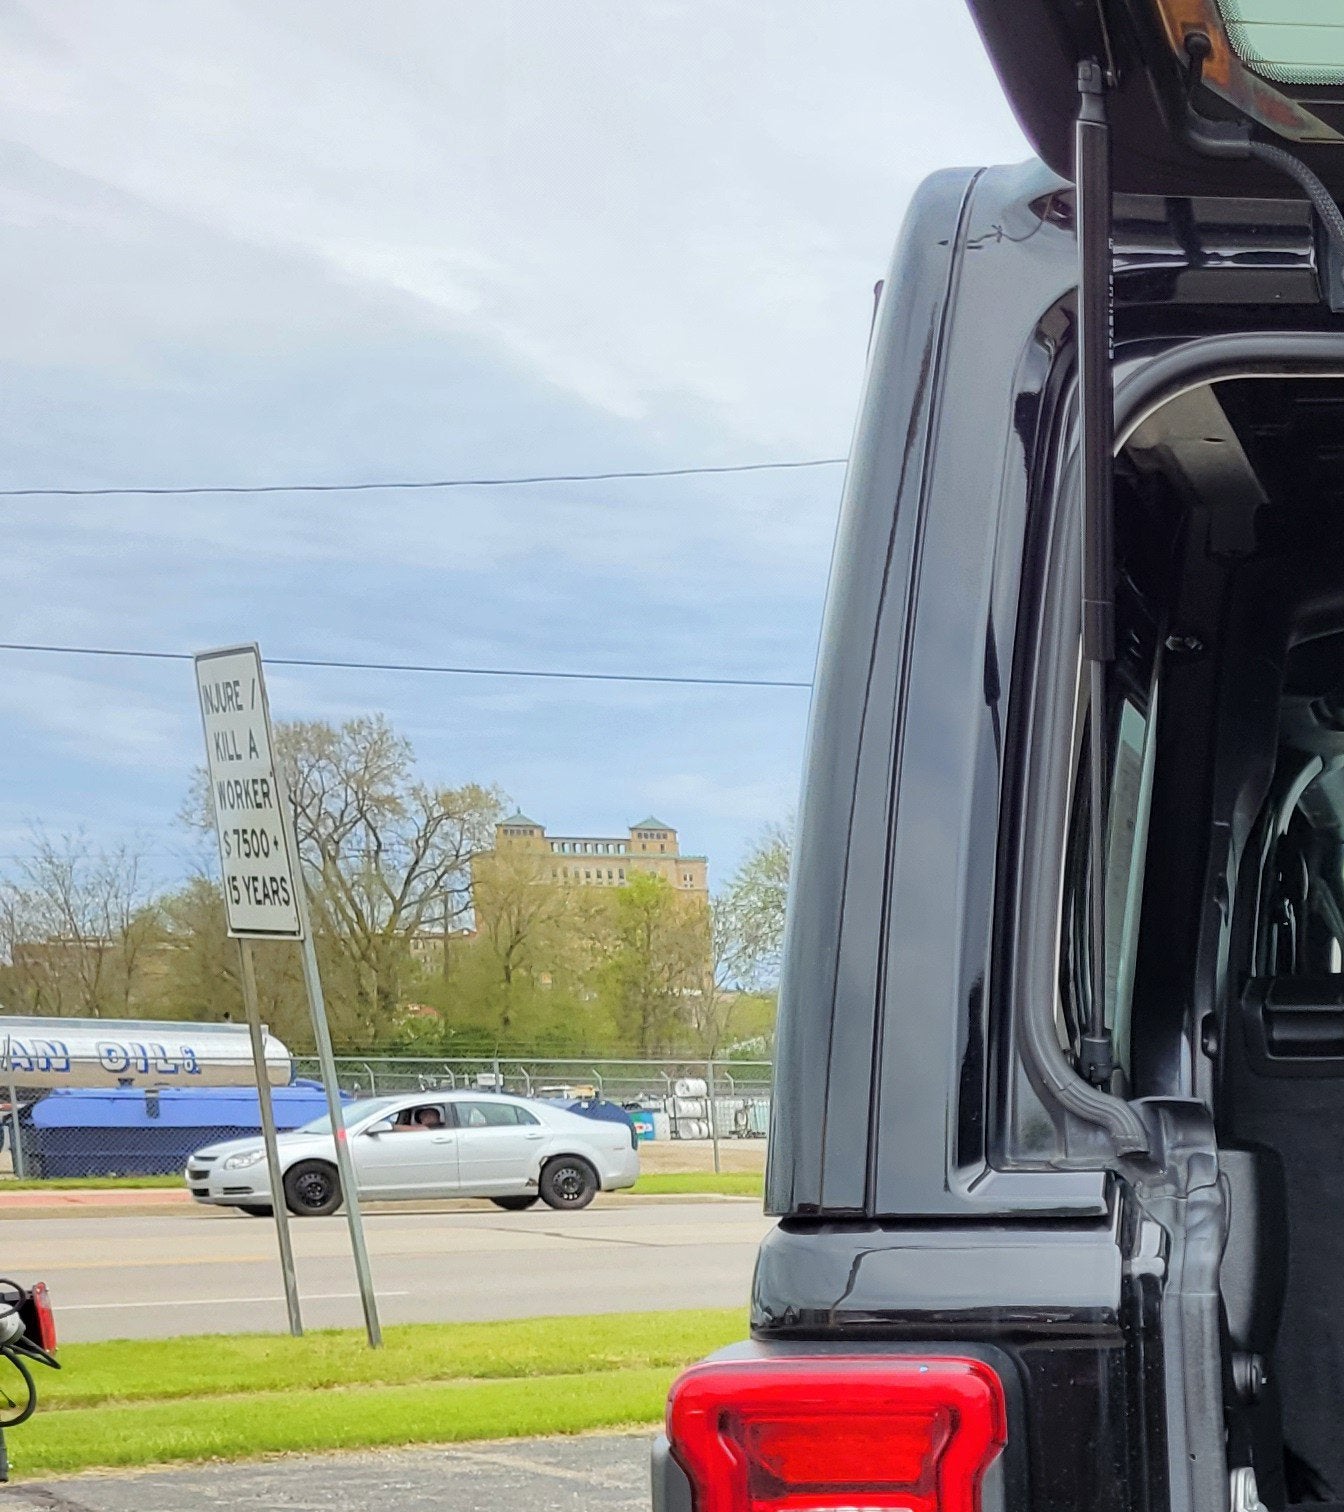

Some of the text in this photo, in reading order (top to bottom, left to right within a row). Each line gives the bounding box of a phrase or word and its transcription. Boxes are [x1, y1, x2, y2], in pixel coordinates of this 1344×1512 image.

[202, 680, 244, 716] INJURE
[213, 728, 260, 762] KILL A
[216, 778, 273, 811] WORKER
[227, 874, 292, 907] 15 YEARS
